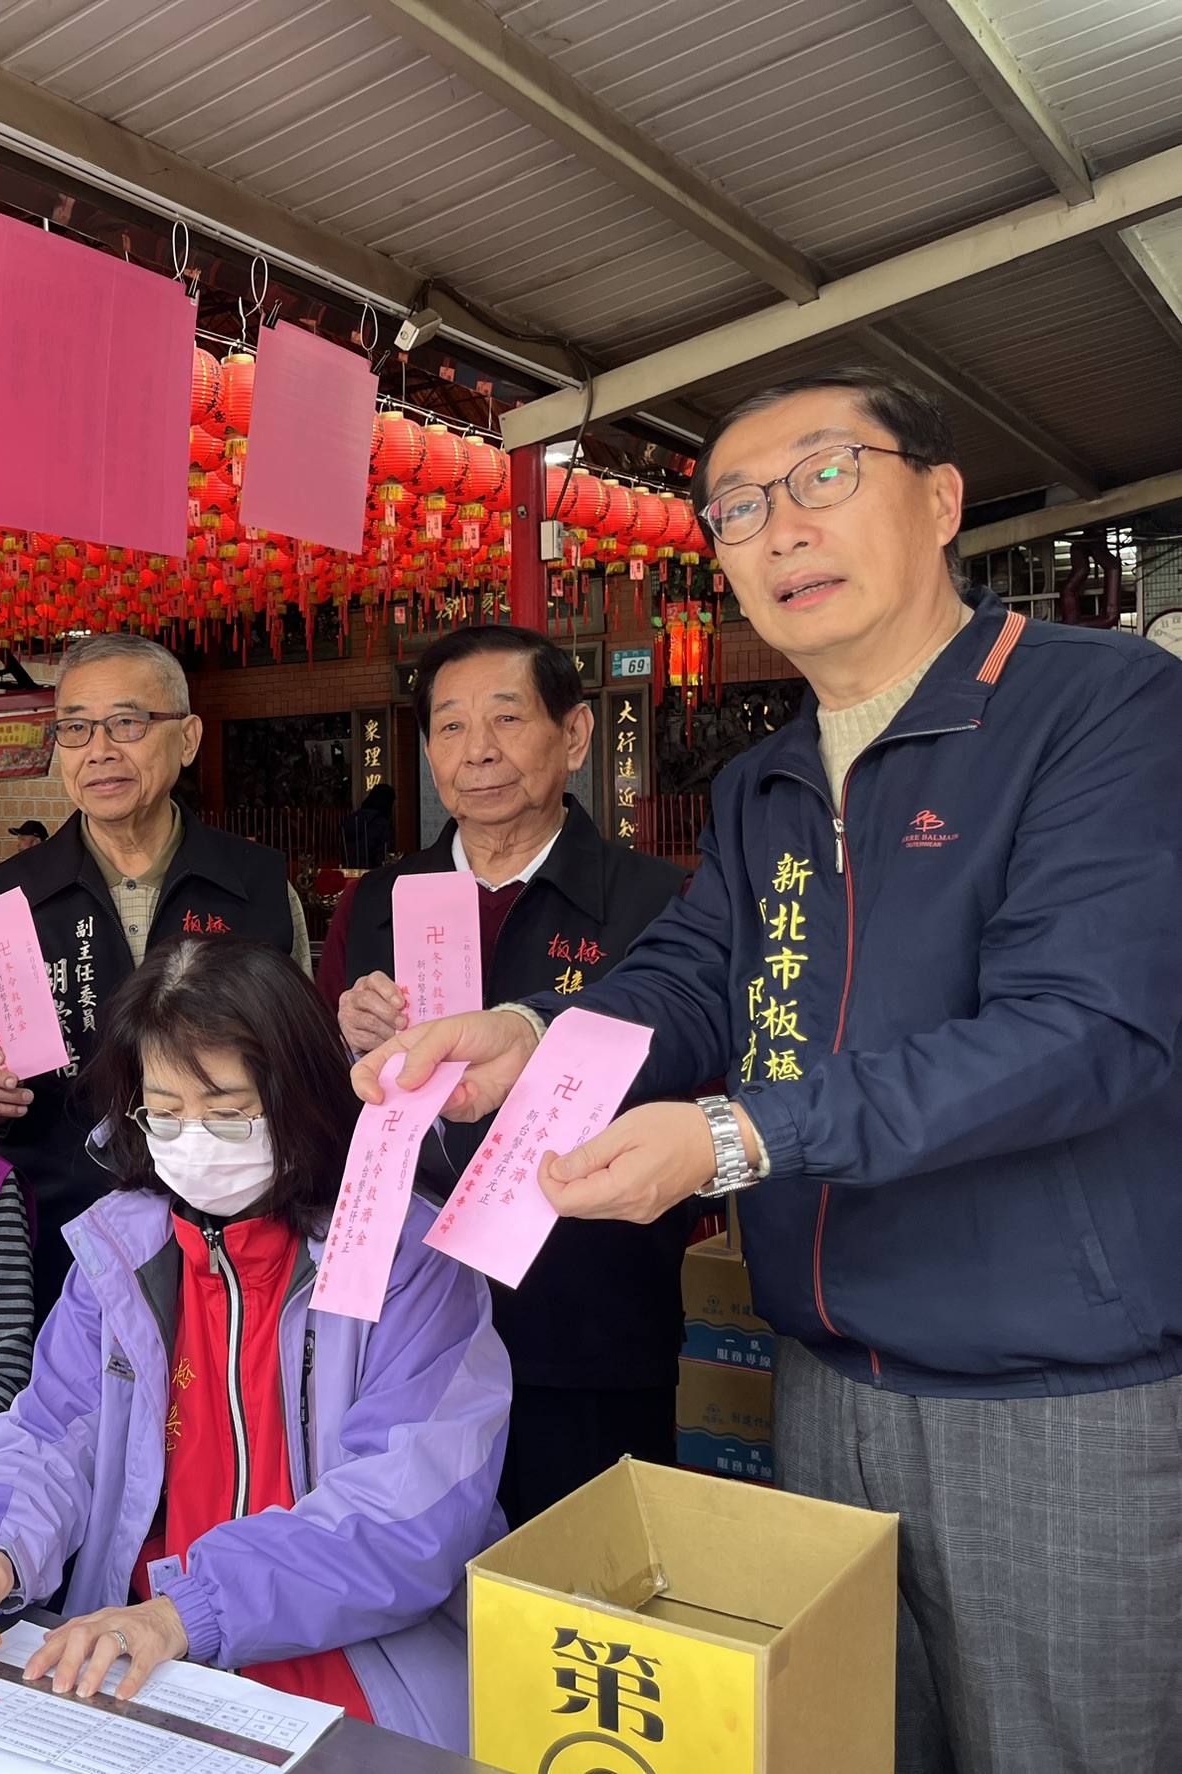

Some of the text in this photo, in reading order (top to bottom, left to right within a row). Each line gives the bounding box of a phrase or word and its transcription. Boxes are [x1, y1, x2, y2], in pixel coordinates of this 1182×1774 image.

[628, 659, 645, 673] 69
[921, 833, 959, 841] BALMAIN
[182, 909, 231, 934] 板橋
[548, 932, 608, 965] 板橋
[74, 915, 98, 1033] 副主任委員
[416, 959, 428, 1024] 新台幣壹仟
[430, 951, 446, 1016] 冬令救濟
[589, 1103, 605, 1122] 三款
[397, 1148, 411, 1191] 0603
[456, 1132, 504, 1208] 板橋接雲寺
[477, 1109, 540, 1206] 新台幣壹仟元正
[499, 1106, 560, 1205] 冬令救濟金
[326, 1181, 353, 1264] 板橋接雲寺
[341, 1150, 374, 1253] 新台幣壹仟元正
[356, 1141, 388, 1246] 冬令救濟金
[716, 1348, 771, 1368] 服務專線
[551, 1626, 663, 1742] 第
